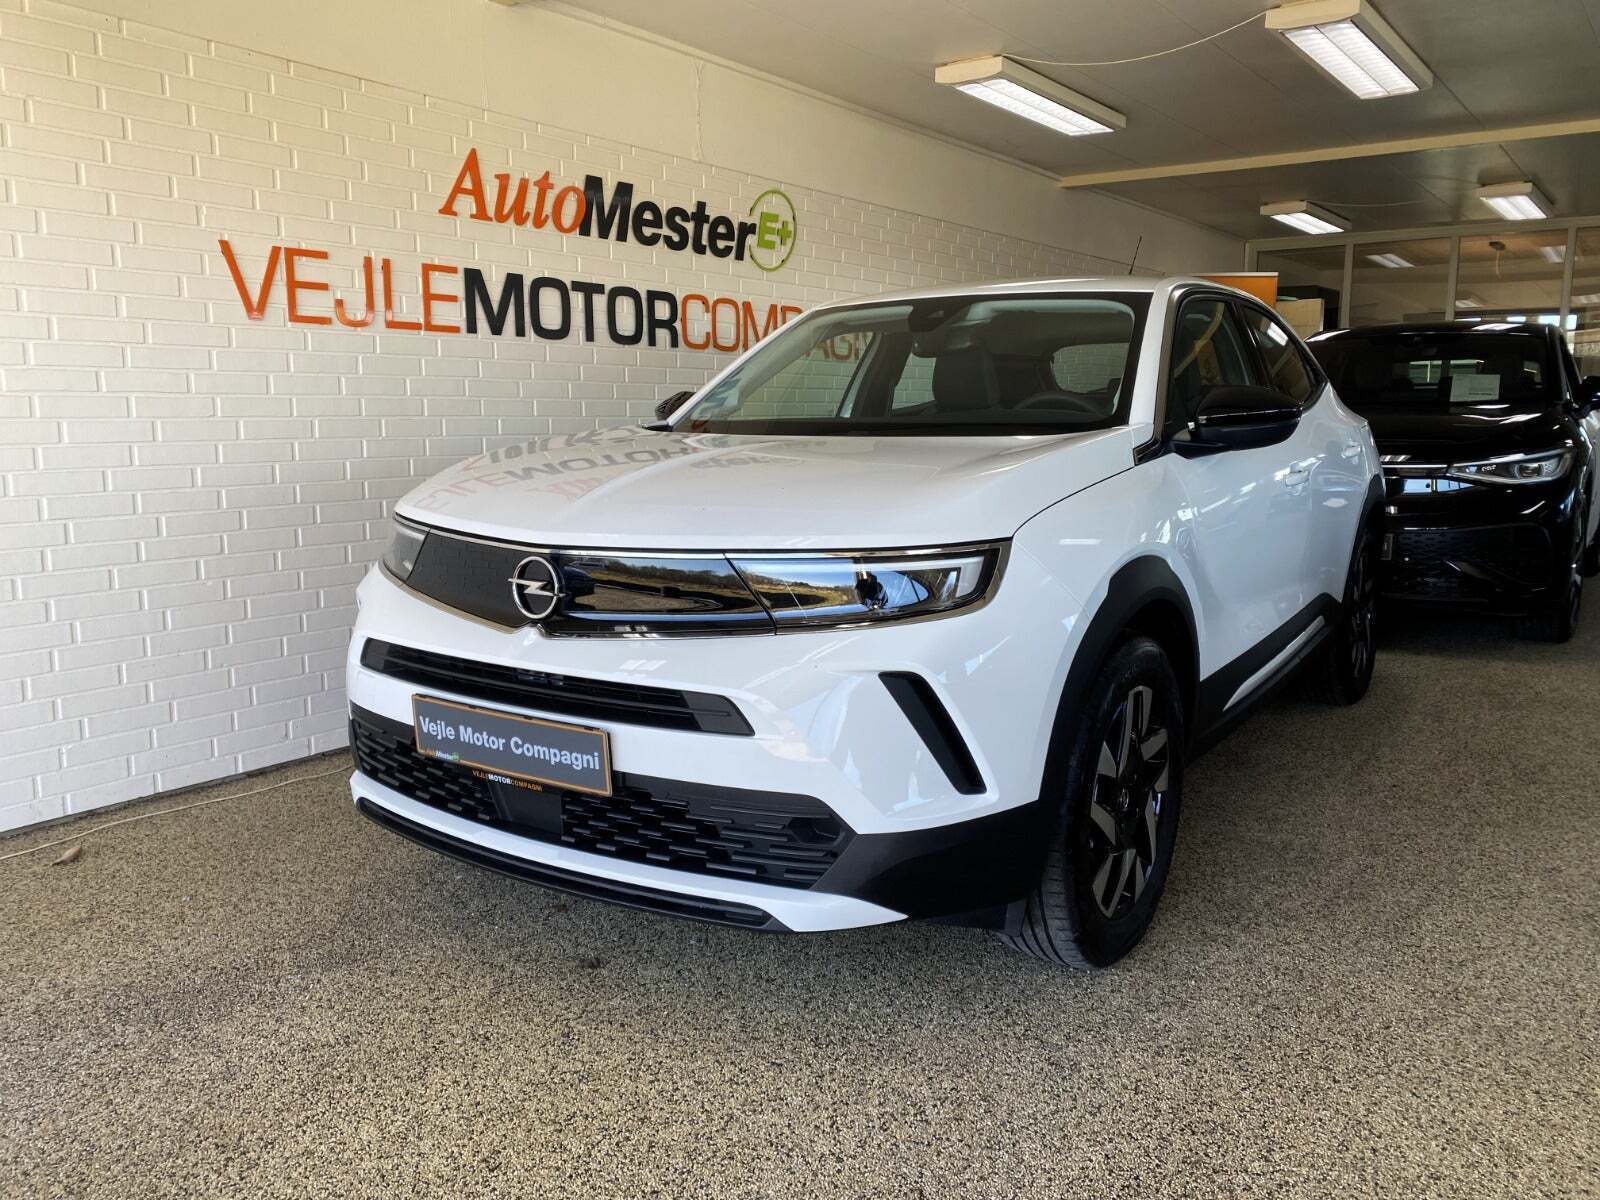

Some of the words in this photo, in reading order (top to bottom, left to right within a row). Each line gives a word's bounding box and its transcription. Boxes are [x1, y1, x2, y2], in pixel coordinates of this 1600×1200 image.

[419, 715, 456, 741] Vejle
[459, 725, 506, 752] Motor
[510, 737, 600, 770] Compagni
